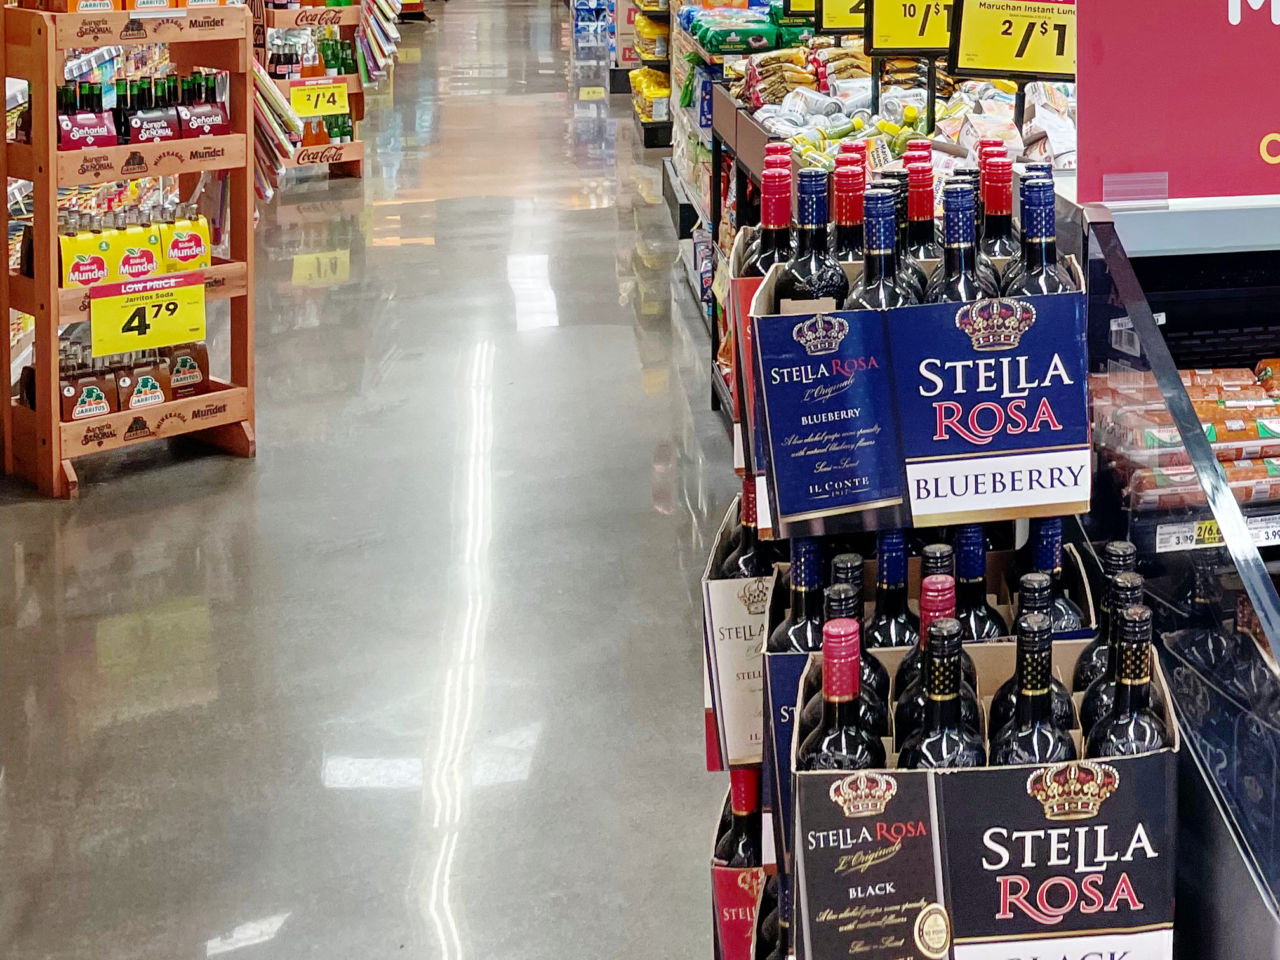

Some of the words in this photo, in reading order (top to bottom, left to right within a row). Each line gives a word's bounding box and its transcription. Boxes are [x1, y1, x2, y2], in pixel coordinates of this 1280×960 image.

[979, 2, 1022, 12] Maruchan
[1025, 5, 1054, 14] Instant
[189, 18, 224, 28] Mundet
[295, 9, 342, 26] Coca-Cola
[190, 115, 222, 129] Señorial
[70, 125, 108, 139] Señorial
[190, 148, 225, 160] Mundet
[297, 146, 343, 165] Coca-Cola
[169, 243, 206, 259] Mundet
[68, 267, 109, 282] Mundet
[119, 261, 158, 275] Mundet
[125, 294, 153, 303] Jarritos
[172, 373, 199, 384] JARRITOS
[771, 363, 830, 385] STELLA
[832, 356, 879, 377] ROSA
[919, 352, 1074, 398] STELLA
[133, 395, 161, 406] JARRITOS
[76, 404, 106, 415] JARRITOS
[192, 404, 227, 420] Mundet
[801, 408, 861, 426] BLUEBERRY
[932, 397, 1063, 445] ROSA
[809, 485, 822, 494] IL
[825, 476, 869, 491] CONTE
[915, 464, 1086, 502] BLUEBERRY
[808, 826, 873, 850] STELLA
[876, 821, 927, 843] ROSA
[982, 822, 1159, 873] STELLA
[849, 882, 896, 899] BLACK
[995, 872, 1145, 925] ROSA
